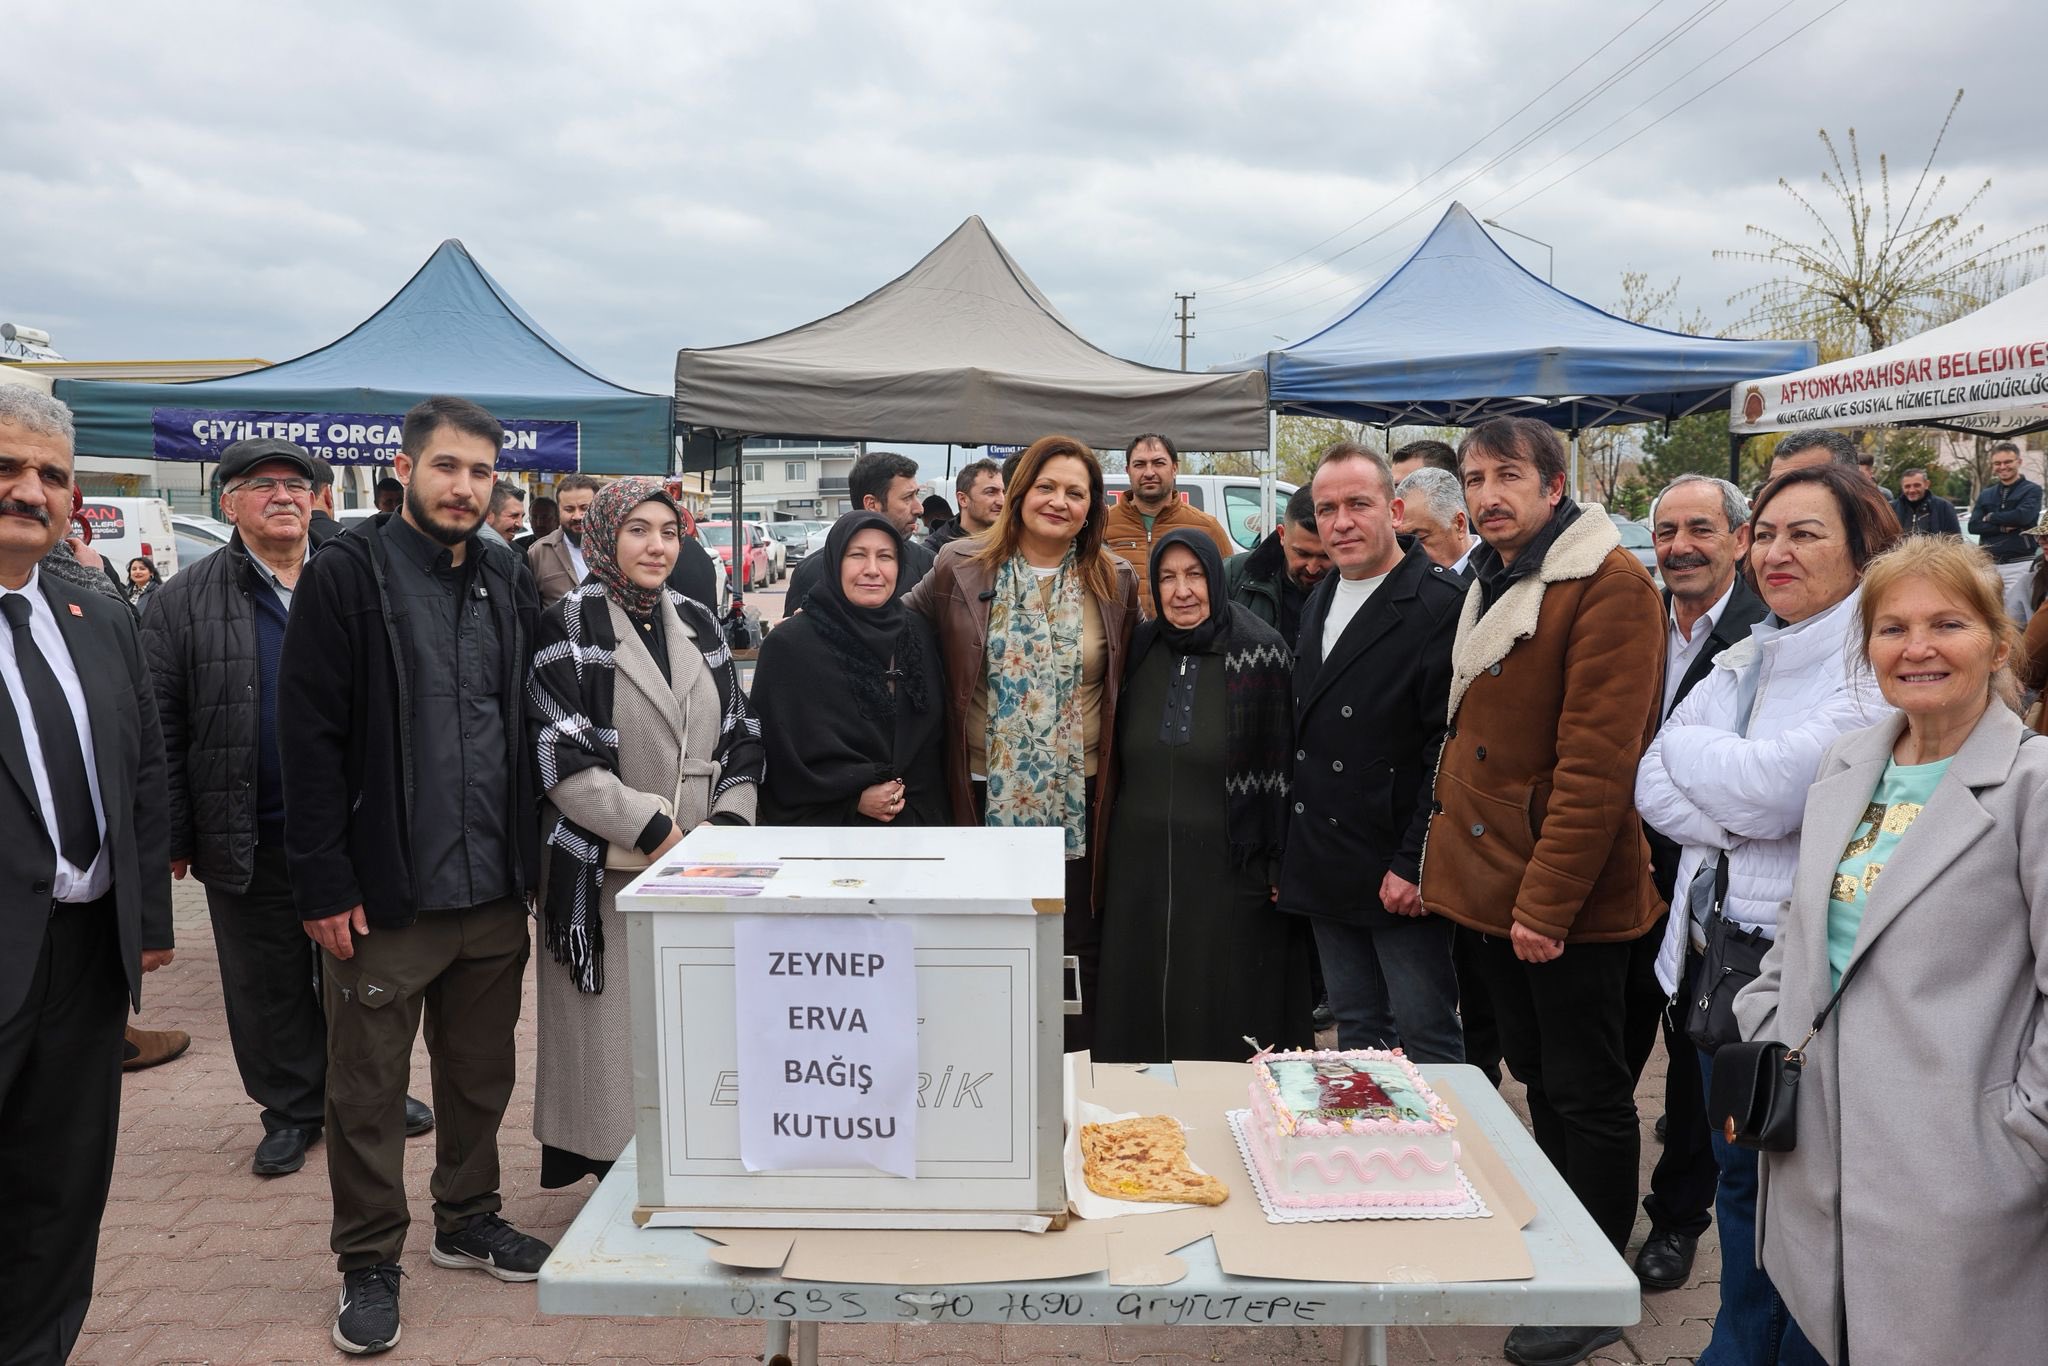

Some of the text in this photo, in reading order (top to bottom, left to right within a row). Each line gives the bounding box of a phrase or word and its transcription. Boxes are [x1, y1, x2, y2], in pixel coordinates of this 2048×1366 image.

[1776, 404, 1832, 425] MUHTARLIK
[1833, 402, 1849, 418] VE
[1850, 396, 1893, 415] SOSYAL
[1896, 386, 1966, 410] HİZMETLER
[312, 446, 333, 459] 76
[336, 447, 359, 459] 90
[768, 952, 885, 978] ZEYNEP
[788, 1006, 868, 1033] ERVA
[784, 1055, 873, 1094] BAĞIŞ
[773, 1112, 896, 1140] KUTUSU
